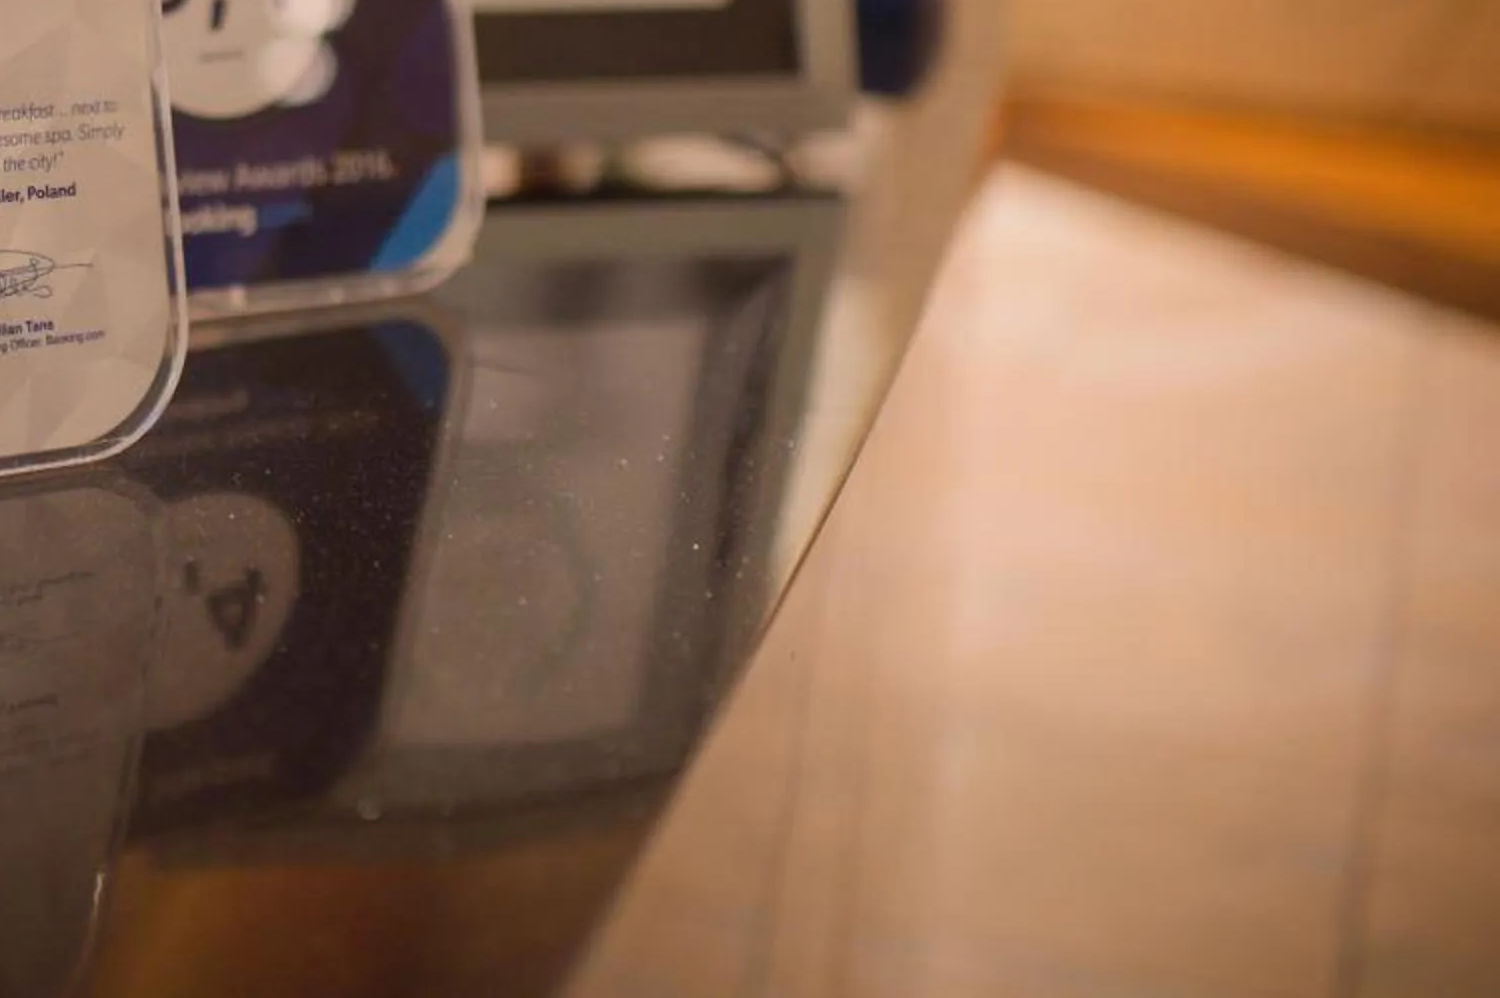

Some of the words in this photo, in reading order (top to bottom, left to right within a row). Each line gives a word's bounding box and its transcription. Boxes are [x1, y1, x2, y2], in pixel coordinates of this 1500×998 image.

[77, 121, 126, 141] Simply
[3, 155, 27, 172] the
[27, 182, 77, 201] Poland
